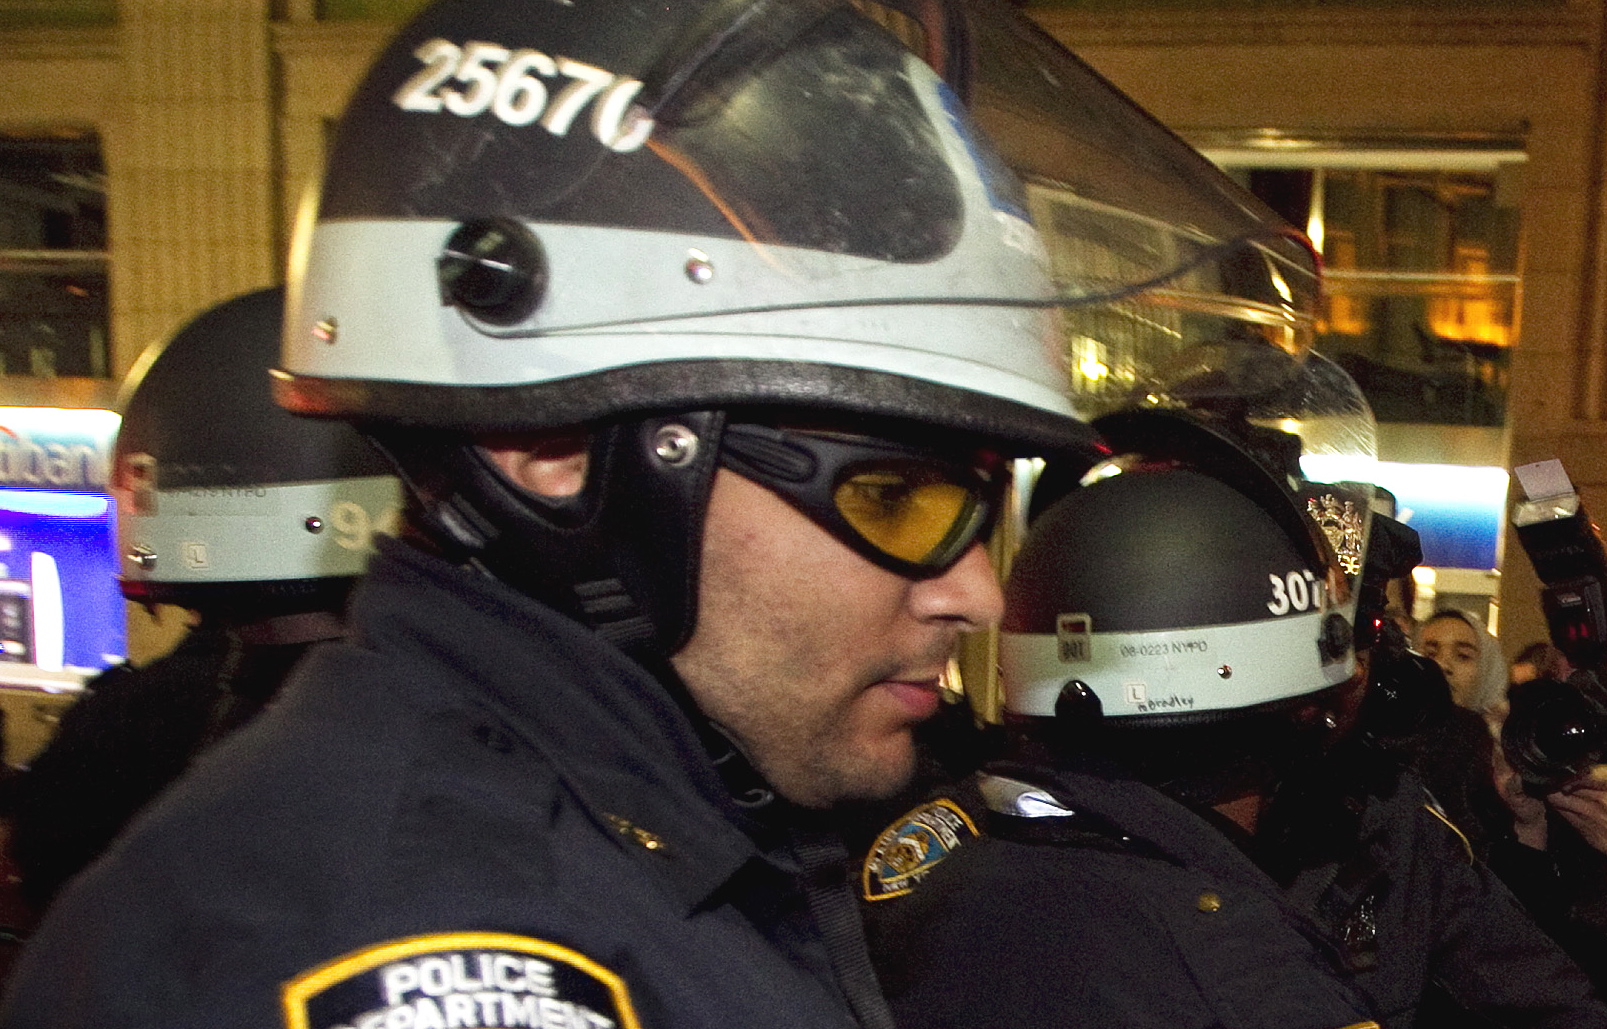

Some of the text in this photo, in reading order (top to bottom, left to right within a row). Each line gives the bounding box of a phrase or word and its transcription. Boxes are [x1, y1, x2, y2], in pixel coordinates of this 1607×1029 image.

[1171, 640, 1208, 654] NYPD
[1132, 687, 1142, 700] L
[379, 953, 557, 1004] POLICE
